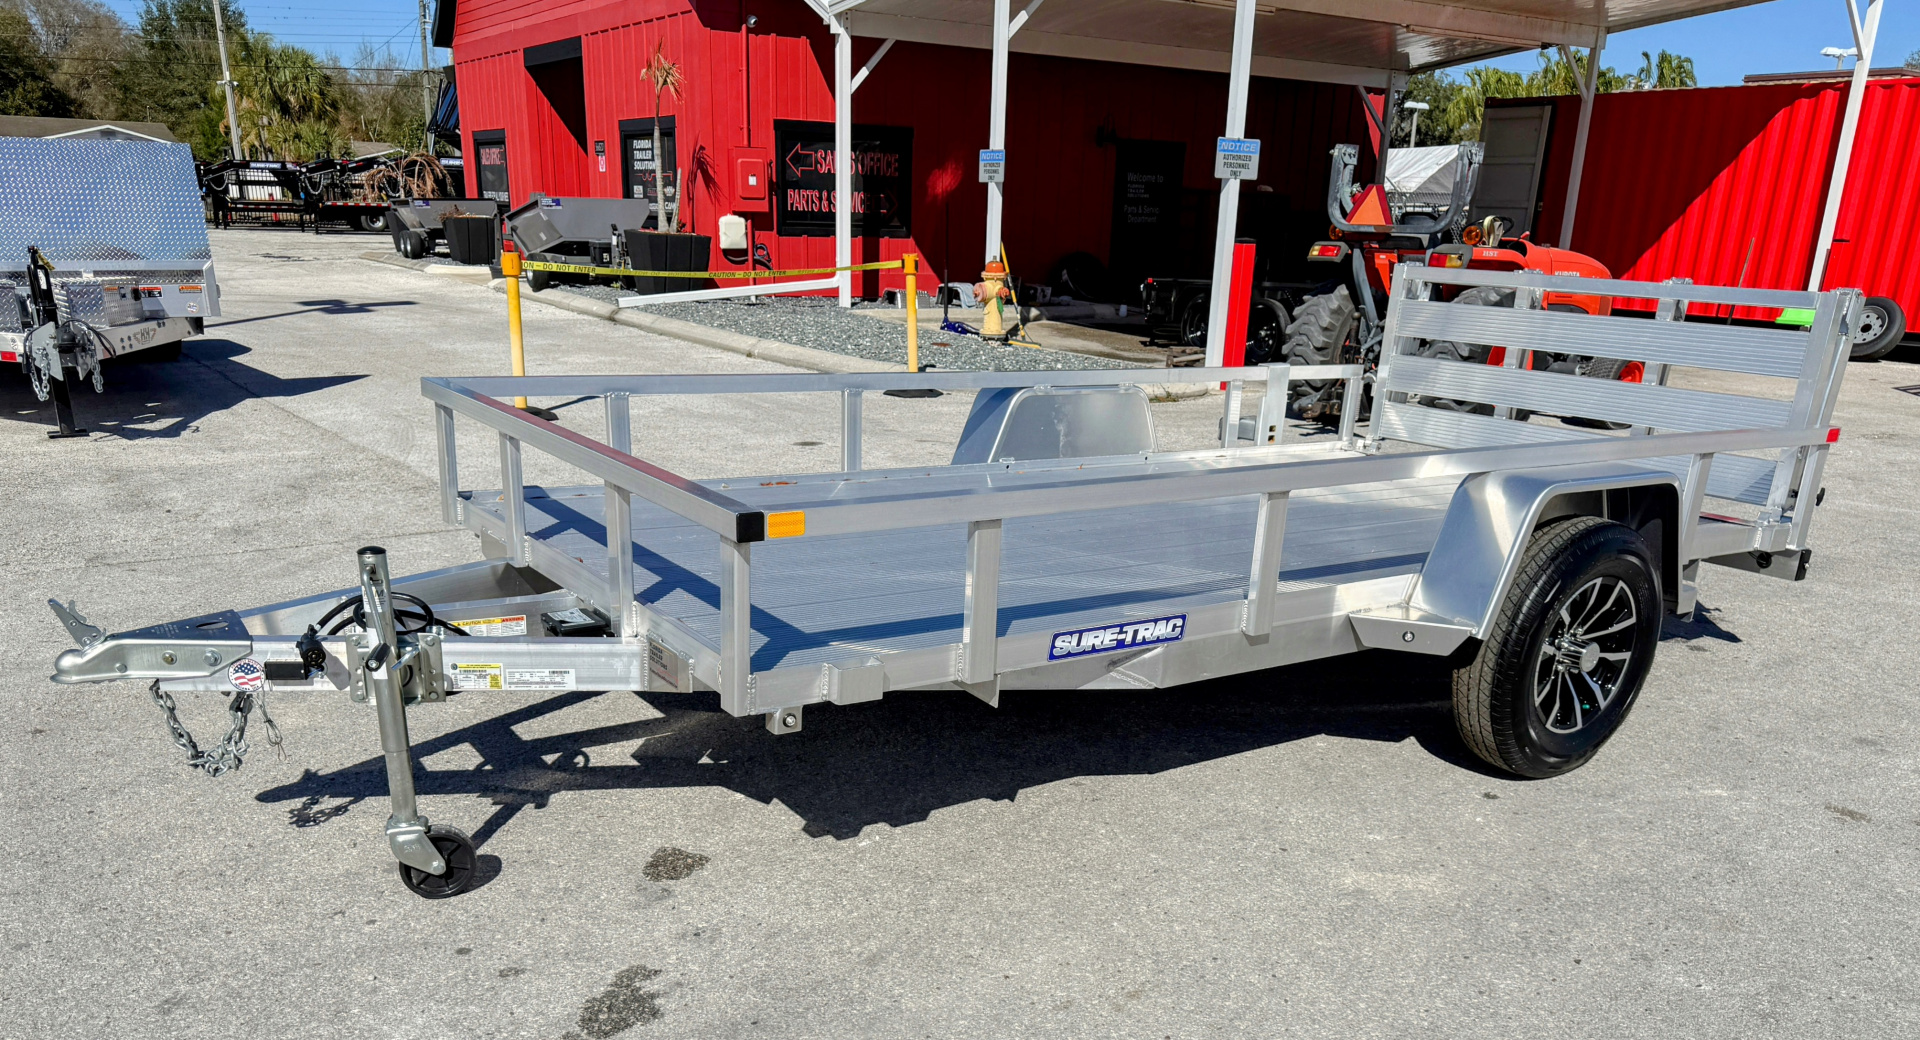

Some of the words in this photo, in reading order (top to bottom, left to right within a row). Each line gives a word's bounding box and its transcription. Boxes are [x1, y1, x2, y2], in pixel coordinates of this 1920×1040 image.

[633, 140, 652, 148] FLORIDA
[1221, 142, 1256, 152] NOTICE
[634, 150, 652, 160] TRAILER
[634, 160, 658, 170] SOLUTION
[817, 150, 855, 174] SAS
[858, 151, 898, 176] OFFICE
[1223, 162, 1250, 170] PERSONNEL
[1128, 172, 1156, 182] Welcome
[787, 188, 820, 212] PARTS
[821, 190, 828, 212] &
[830, 191, 871, 214] SVICE
[1052, 618, 1182, 656] SURE-TRAC
